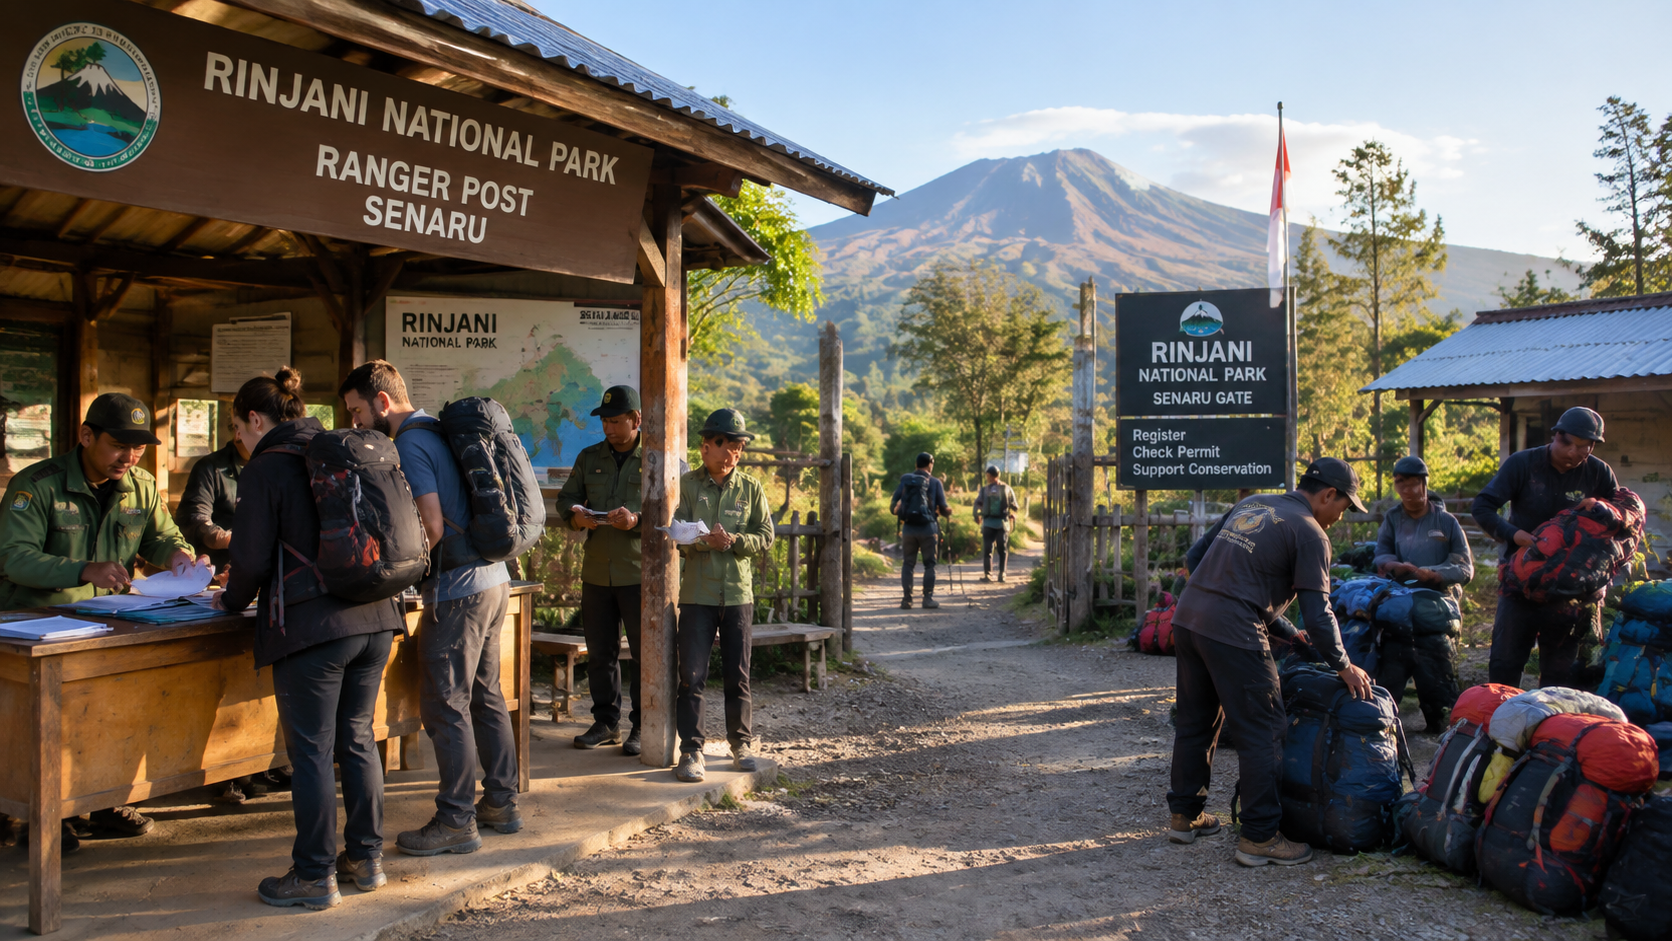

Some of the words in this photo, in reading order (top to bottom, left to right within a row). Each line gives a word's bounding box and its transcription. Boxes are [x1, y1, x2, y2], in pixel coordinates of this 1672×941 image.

[204, 51, 369, 126] RINJANI
[382, 97, 539, 168] NATIONAL
[549, 141, 620, 185] PARK
[316, 144, 451, 200] RANGER
[461, 175, 534, 217] POST
[363, 195, 488, 245] SENARU
[402, 312, 497, 334] RINJANI
[402, 336, 461, 349] NATIONAL
[466, 336, 497, 349] PARK
[1151, 340, 1252, 363] RINJANI
[1138, 368, 1218, 382] NATIONAL
[1224, 367, 1267, 382] PARK
[1153, 391, 1211, 405] SENARU
[1216, 391, 1253, 404] GATE
[1132, 428, 1186, 444] Register
[1132, 445, 1173, 458] Check
[1178, 445, 1220, 458] Permit
[1132, 463, 1184, 478] Support
[1188, 462, 1272, 475] Conservation
